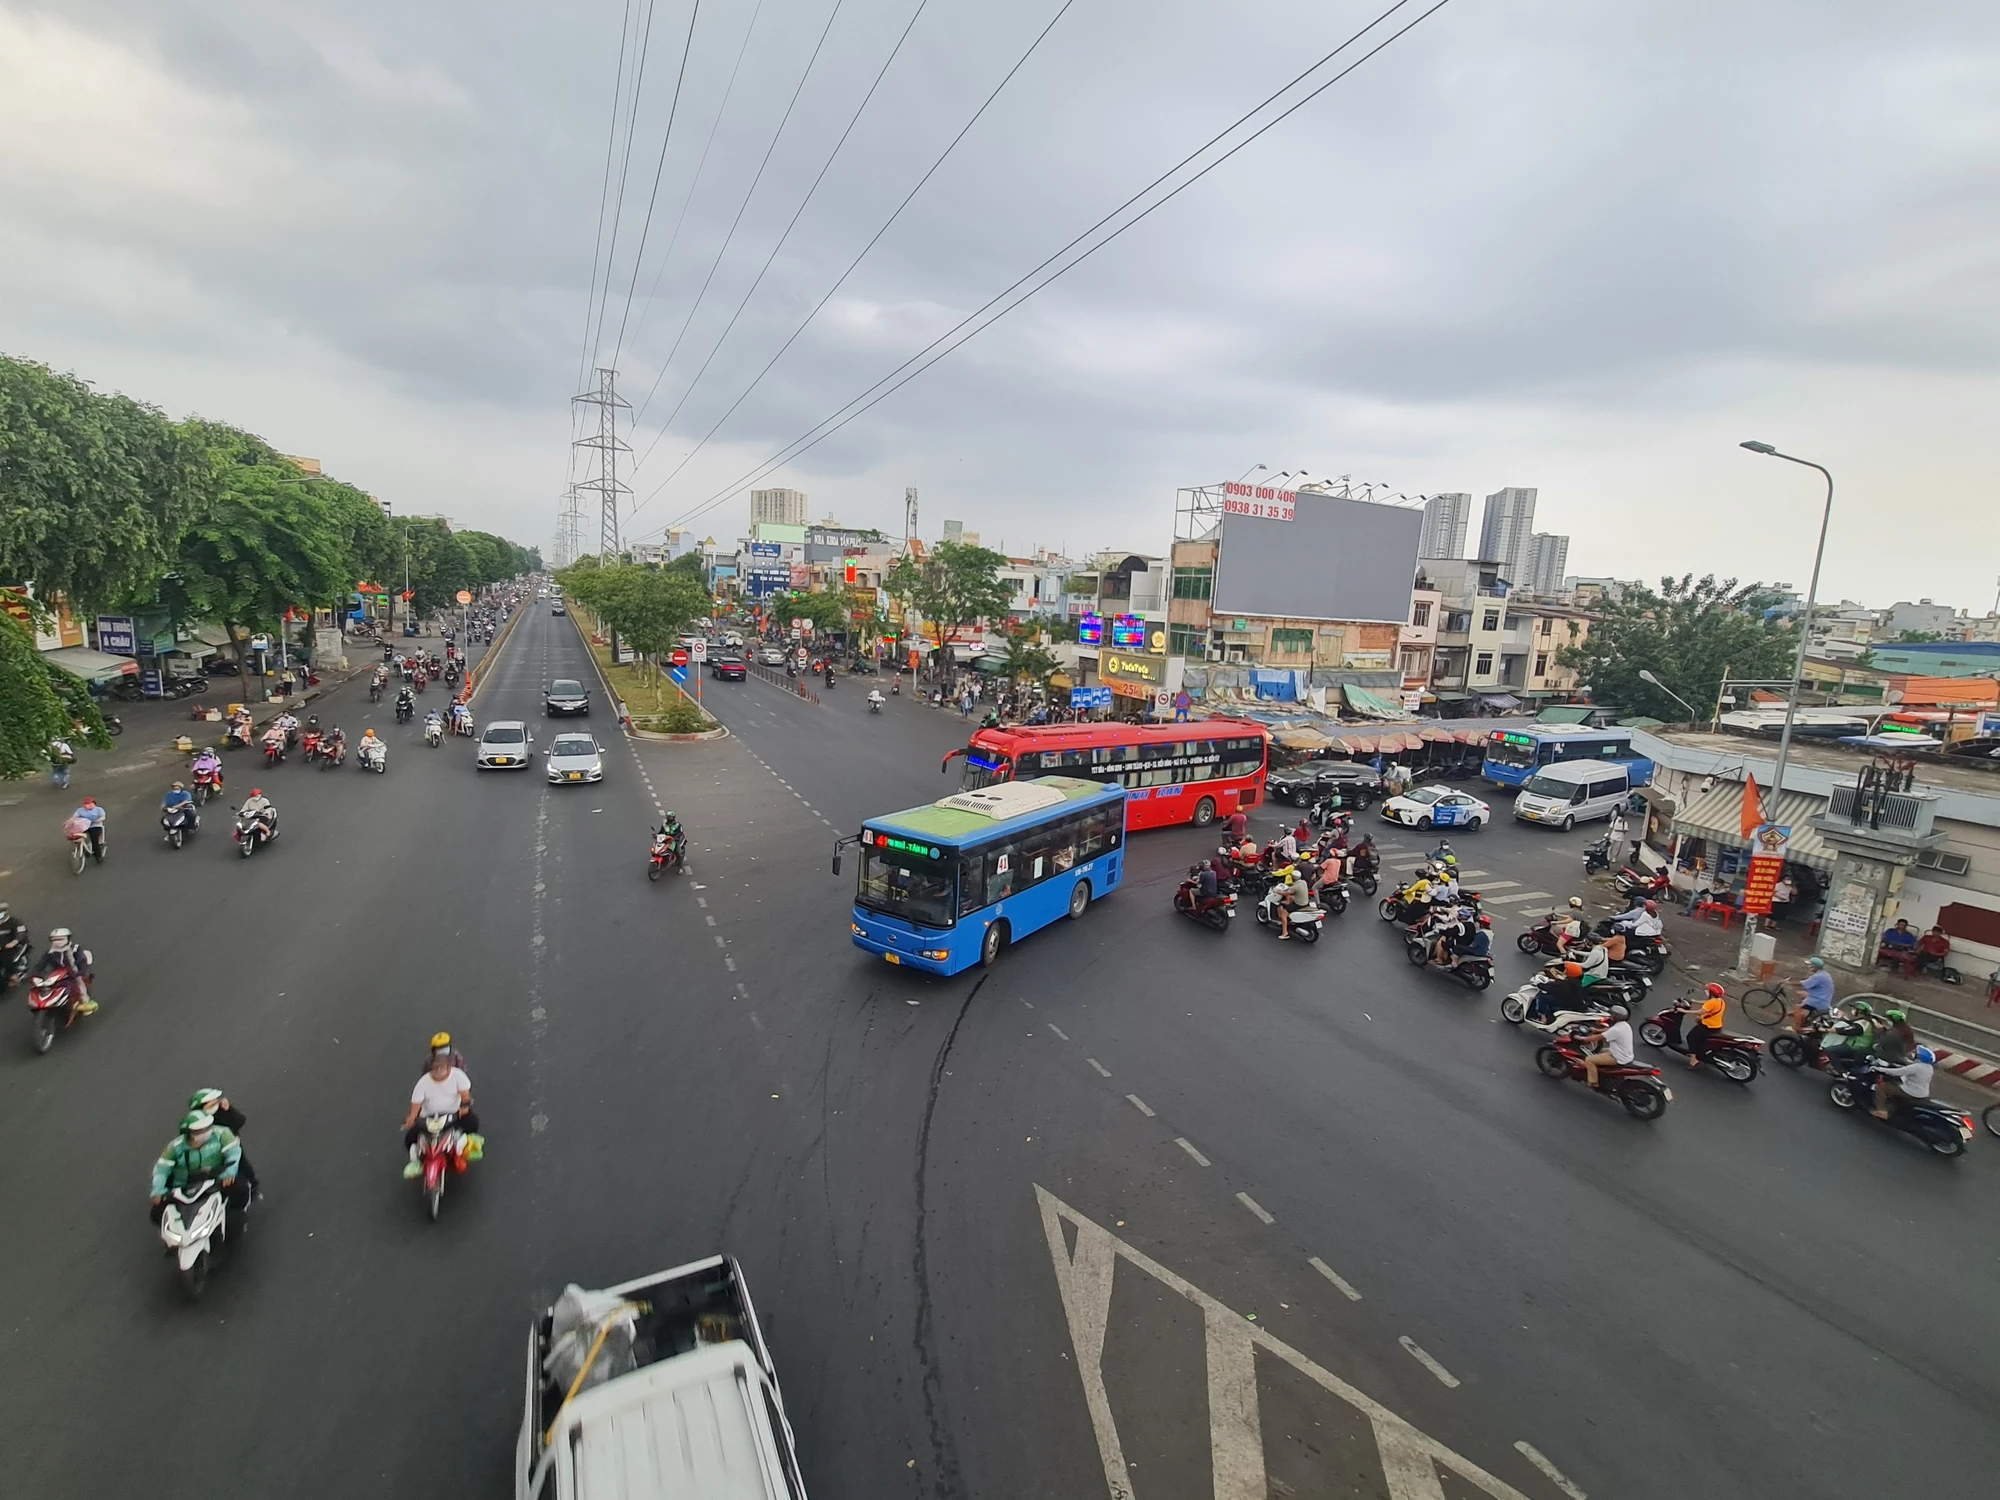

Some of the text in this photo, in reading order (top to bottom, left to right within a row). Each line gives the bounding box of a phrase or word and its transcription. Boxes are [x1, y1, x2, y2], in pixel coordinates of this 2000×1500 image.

[1226, 482, 1295, 503] 0903 000 406
[1225, 500, 1294, 520] 0938 31 35 39
[865, 831, 872, 842] 41
[876, 835, 888, 847] 41
[1000, 858, 1007, 870] 41
